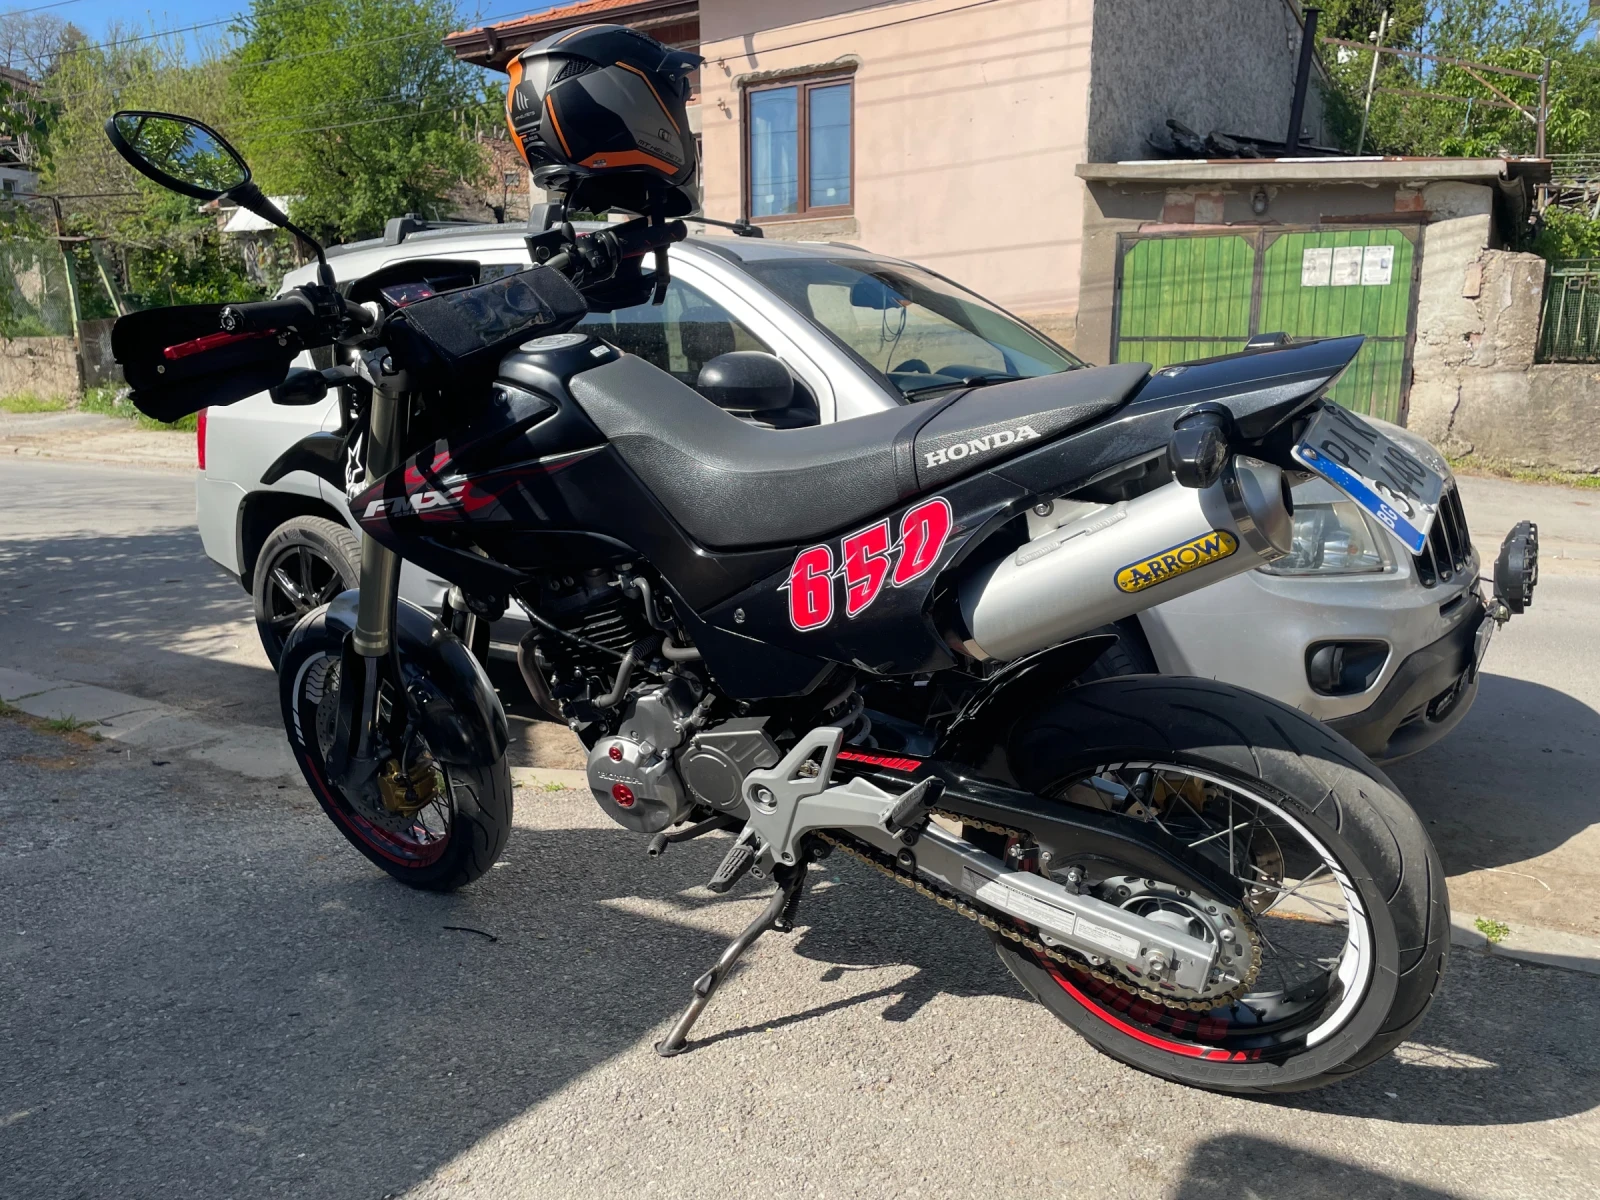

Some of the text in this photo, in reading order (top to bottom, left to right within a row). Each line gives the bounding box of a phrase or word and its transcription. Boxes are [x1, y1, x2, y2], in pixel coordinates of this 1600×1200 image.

[925, 425, 1041, 468] HONDA
[362, 485, 465, 518] FMX
[1374, 446, 1427, 519] 3448
[1376, 503, 1399, 529] BG
[777, 496, 953, 632] 650
[1128, 534, 1220, 586] ARROW
[1188, 1055, 1316, 1081] MICHELIN
